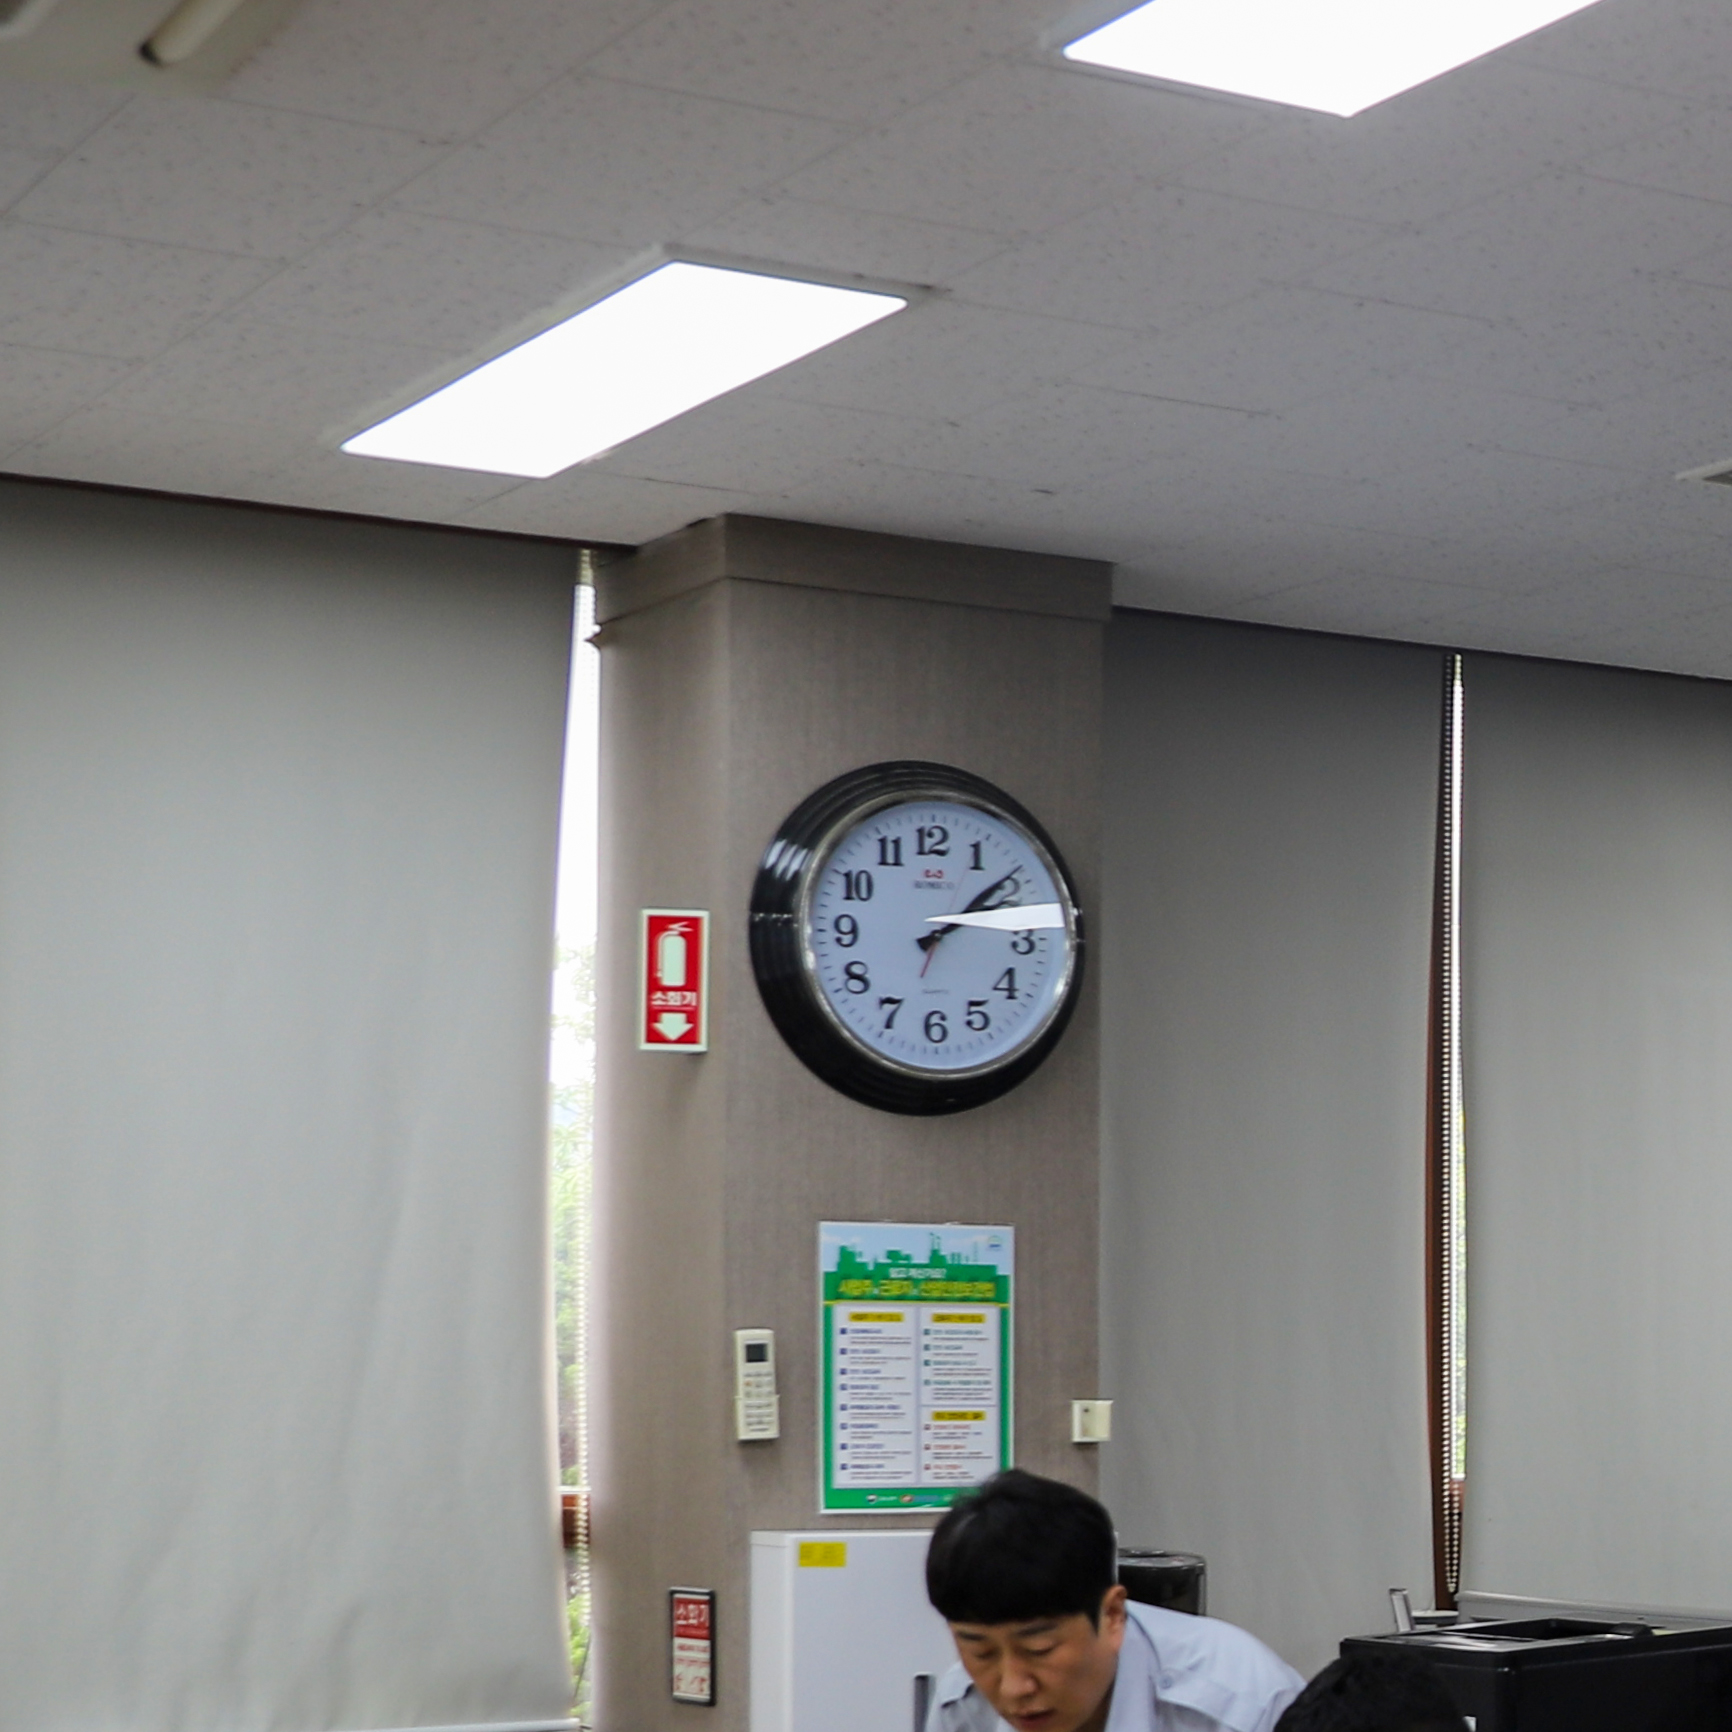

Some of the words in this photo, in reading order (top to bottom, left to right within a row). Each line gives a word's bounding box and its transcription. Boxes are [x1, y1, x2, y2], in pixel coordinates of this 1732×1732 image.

[877, 836, 904, 866] 11
[916, 825, 949, 856] 12
[969, 841, 985, 871] 1
[843, 870, 873, 901] 10
[834, 914, 859, 947] 9
[1011, 929, 1036, 955] 3
[844, 961, 870, 994] 8
[992, 967, 1019, 1000] 4
[651, 991, 697, 1006] 소화기
[878, 996, 904, 1029] 7
[924, 1010, 948, 1043] 6
[965, 1000, 990, 1031] 5
[675, 1604, 709, 1627] 소화기
